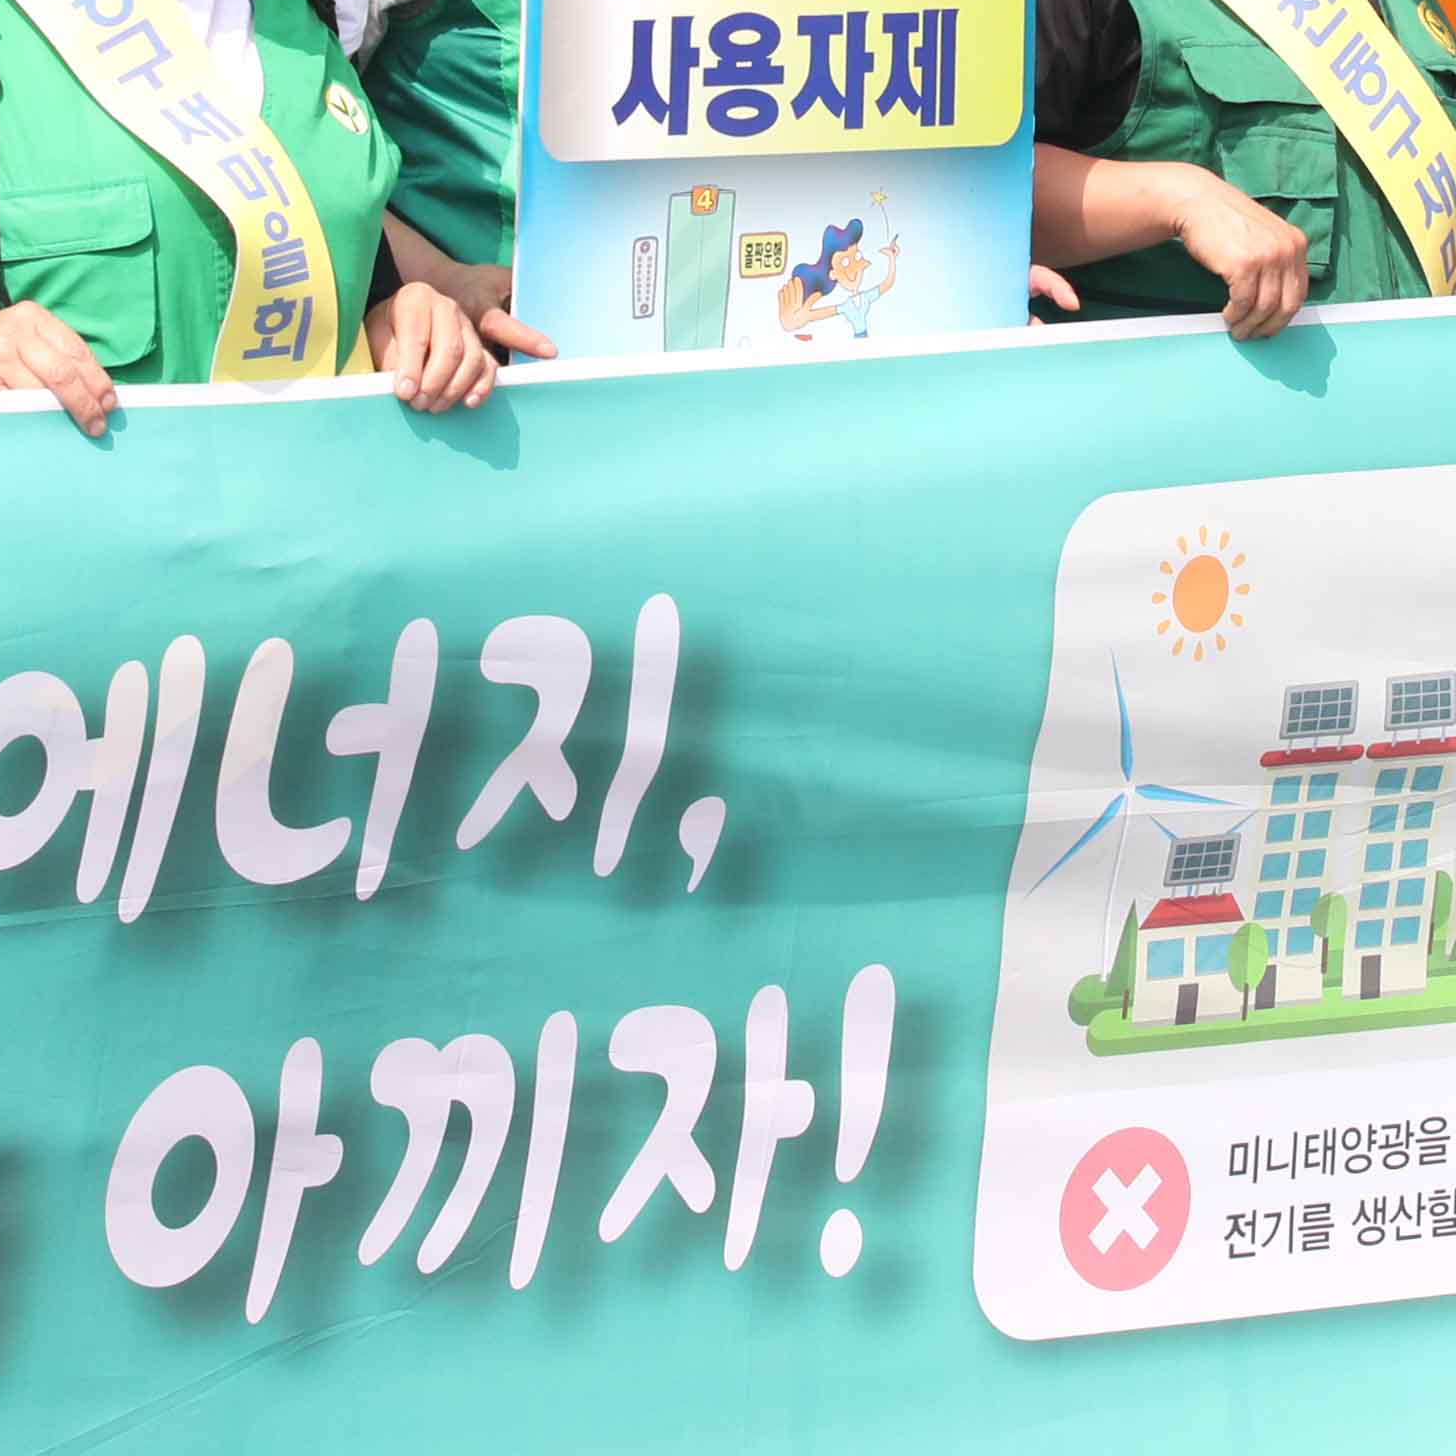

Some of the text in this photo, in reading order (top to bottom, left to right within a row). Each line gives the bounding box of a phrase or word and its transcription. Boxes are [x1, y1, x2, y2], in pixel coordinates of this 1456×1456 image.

[611, 8, 960, 138] 사용자제
[696, 190, 713, 211] 4
[104, 964, 896, 1325] 아끼자!
[1228, 1116, 1451, 1184] 미니태양광을
[1224, 1201, 1335, 1259] 전기를
